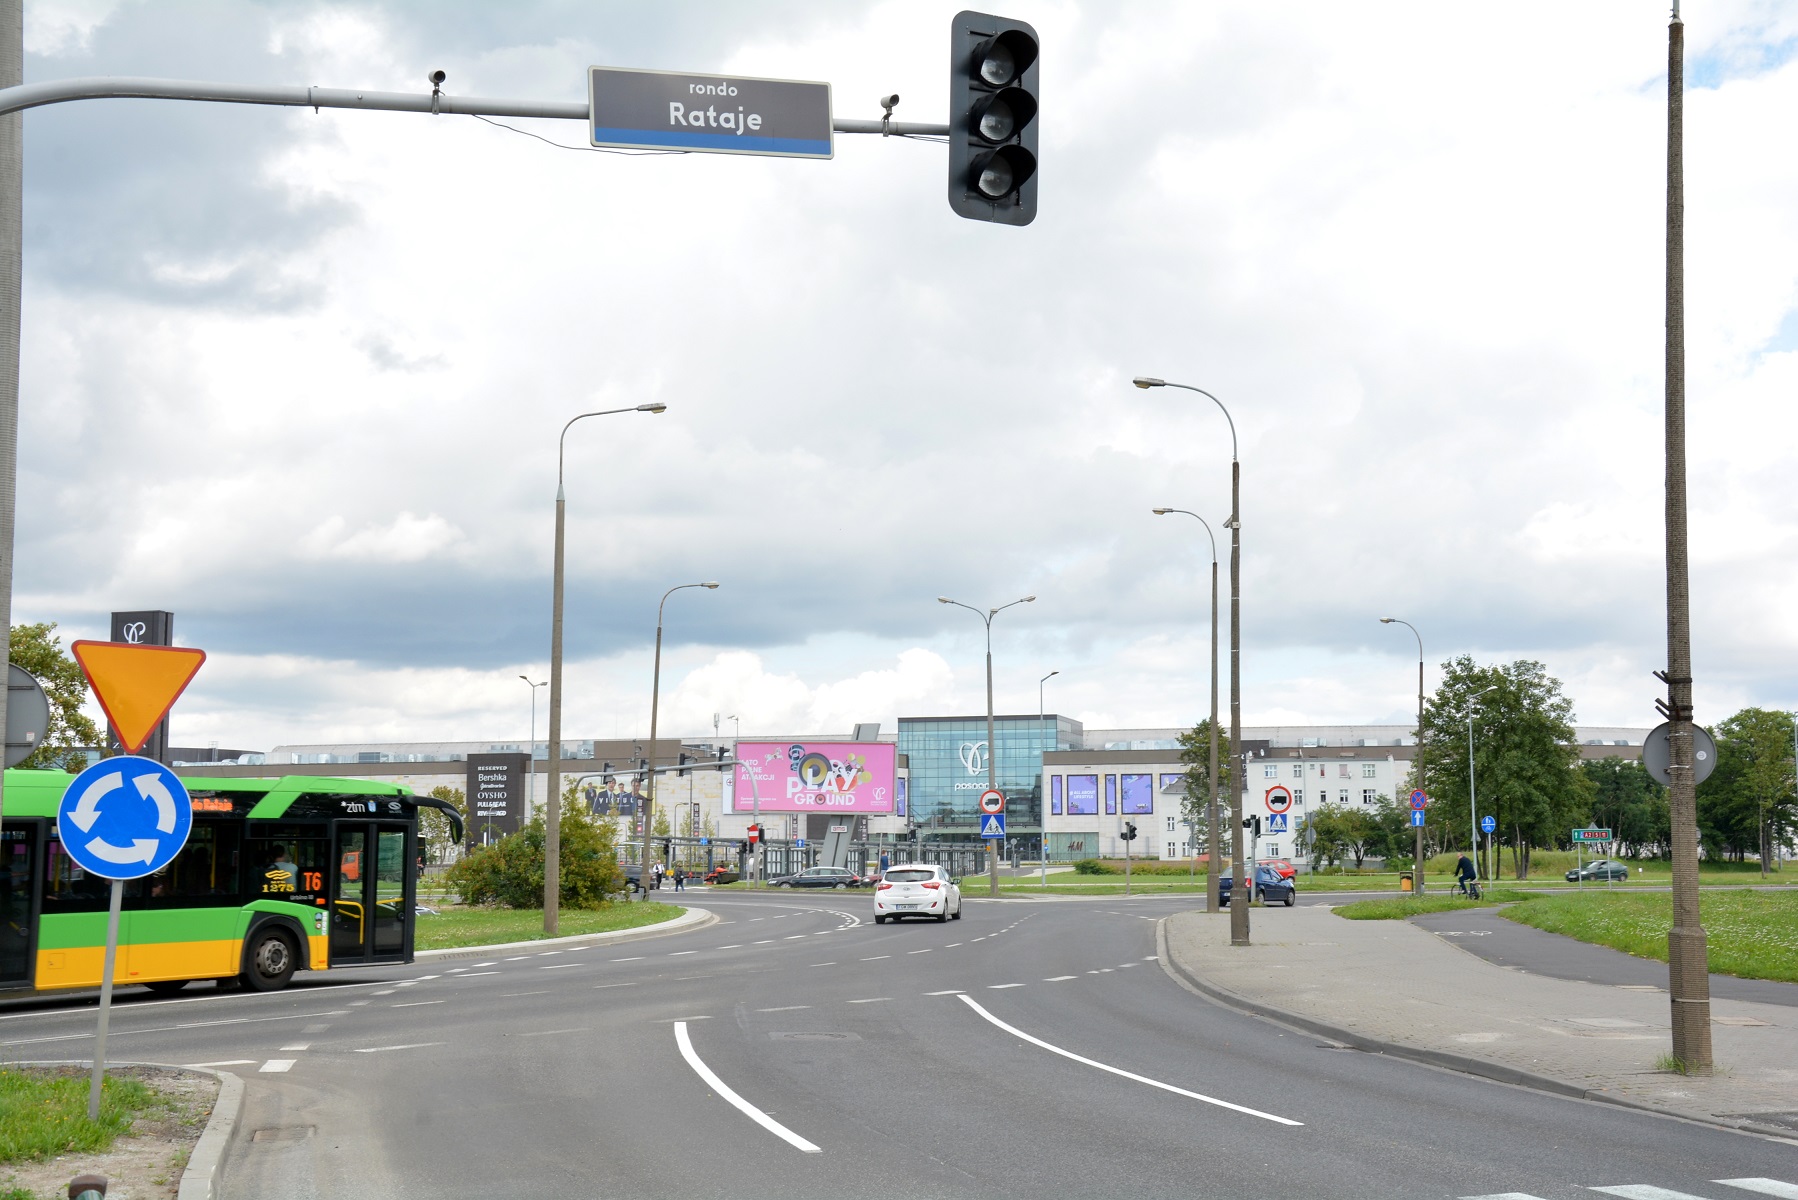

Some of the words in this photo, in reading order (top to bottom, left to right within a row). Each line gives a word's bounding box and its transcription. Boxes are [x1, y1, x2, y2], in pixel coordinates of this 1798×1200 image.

[689, 81, 738, 97] rondo
[669, 101, 762, 135] Rataje
[478, 773, 507, 781] Bershka
[786, 768, 858, 799] PLAY
[477, 791, 507, 799] OYSHO
[794, 793, 856, 806] GROUND
[1067, 841, 1084, 852] H&M
[303, 872, 322, 891] T6
[261, 884, 295, 893] 1275
